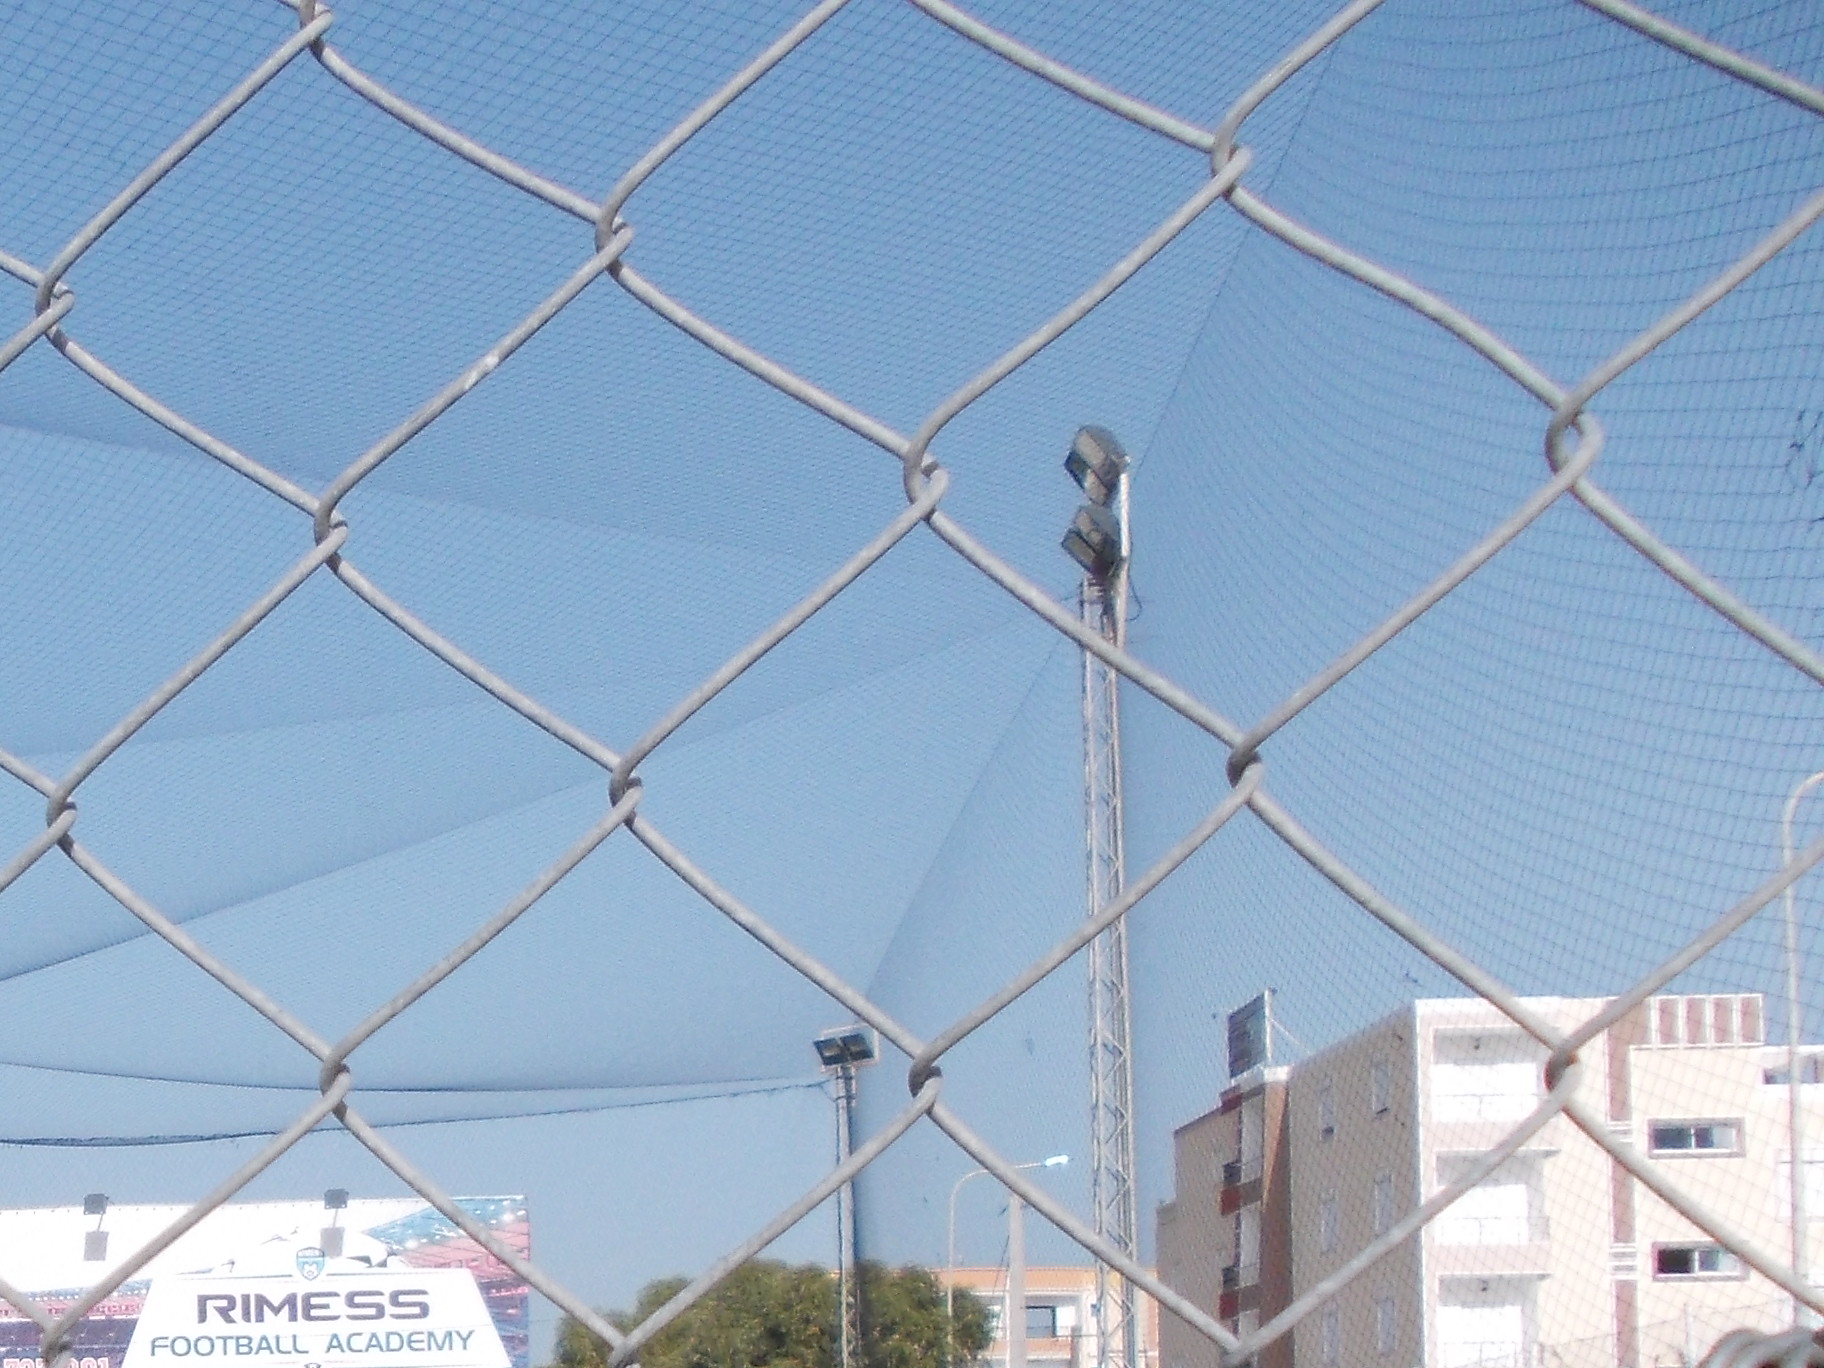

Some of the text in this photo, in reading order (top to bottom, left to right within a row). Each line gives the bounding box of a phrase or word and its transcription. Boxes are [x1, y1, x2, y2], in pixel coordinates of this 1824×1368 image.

[196, 1289, 430, 1324] RIMESS
[150, 1329, 475, 1357] FOOTBALL ACADEMY
